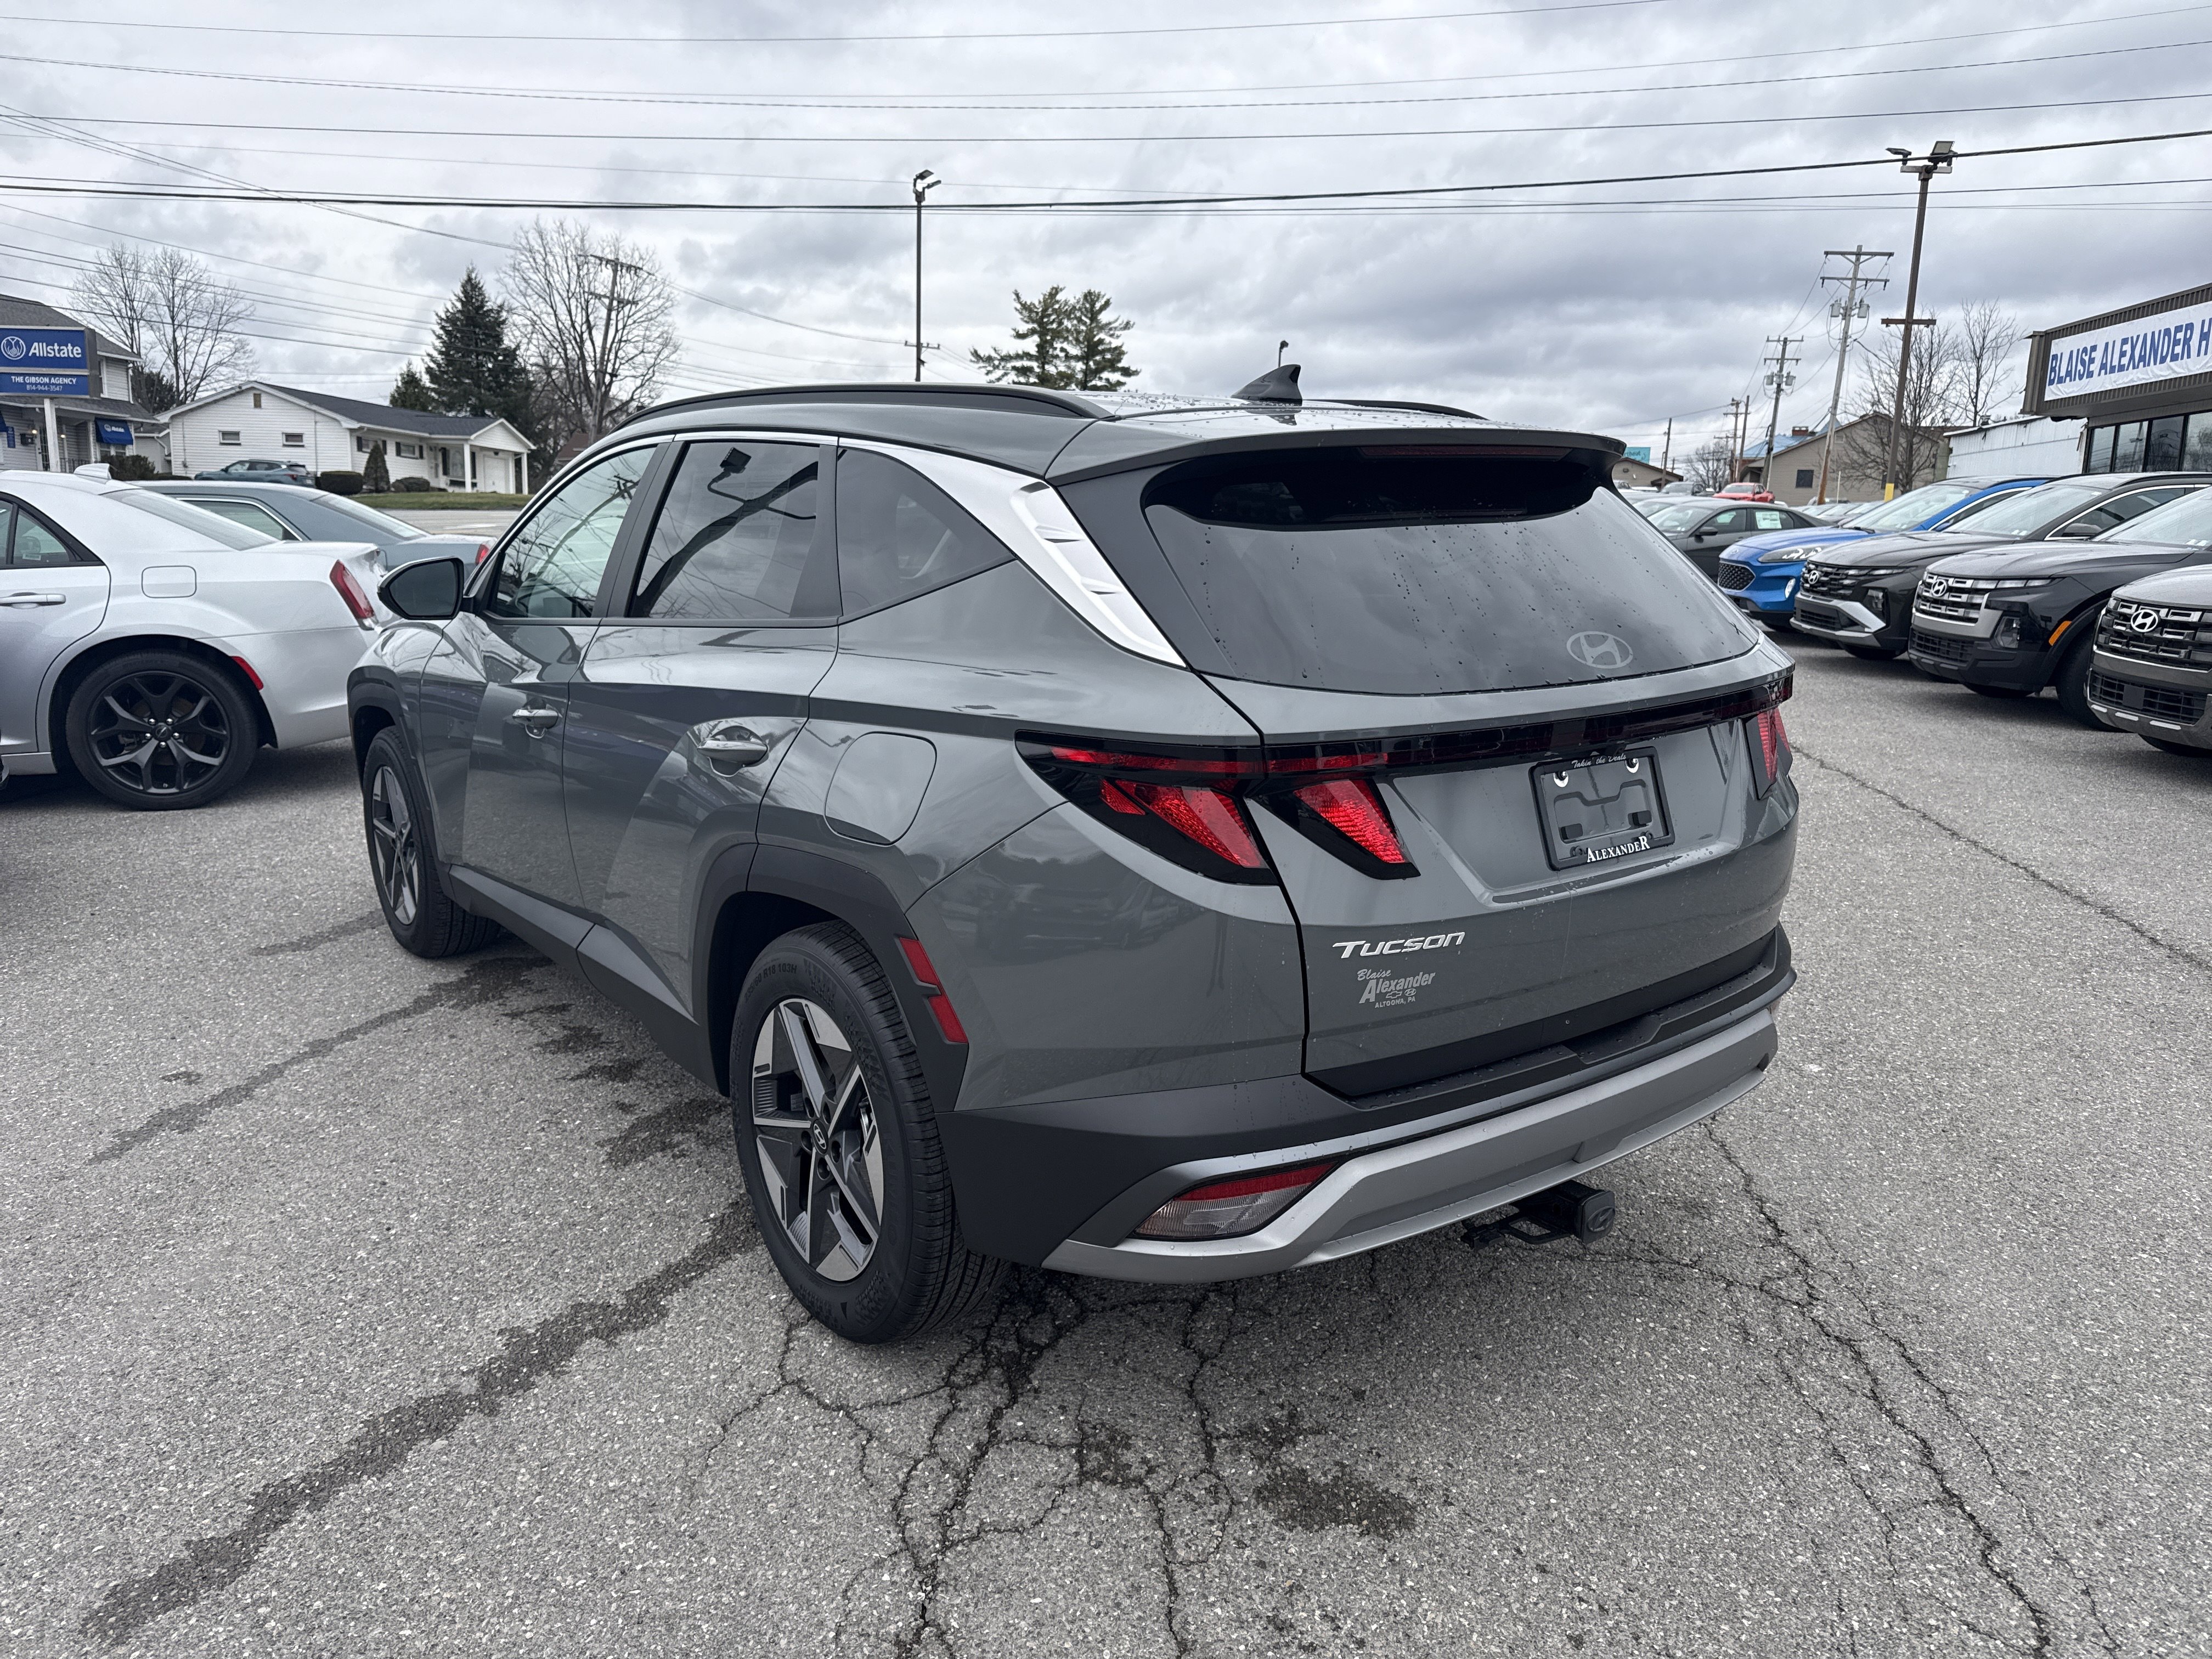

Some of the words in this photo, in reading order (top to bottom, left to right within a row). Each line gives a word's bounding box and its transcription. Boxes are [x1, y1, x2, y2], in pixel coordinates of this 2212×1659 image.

[29, 342, 82, 358] Allstate
[2048, 344, 2097, 386] BLAISE
[2098, 322, 2194, 376] ALEXANDER
[1596, 756, 1606, 764] the
[1587, 836, 1650, 863] ALEXANDER
[763, 964, 776, 979] R18
[778, 963, 797, 974] 103H
[1357, 969, 1391, 981] Blaise
[1359, 972, 1436, 1003] Alexander
